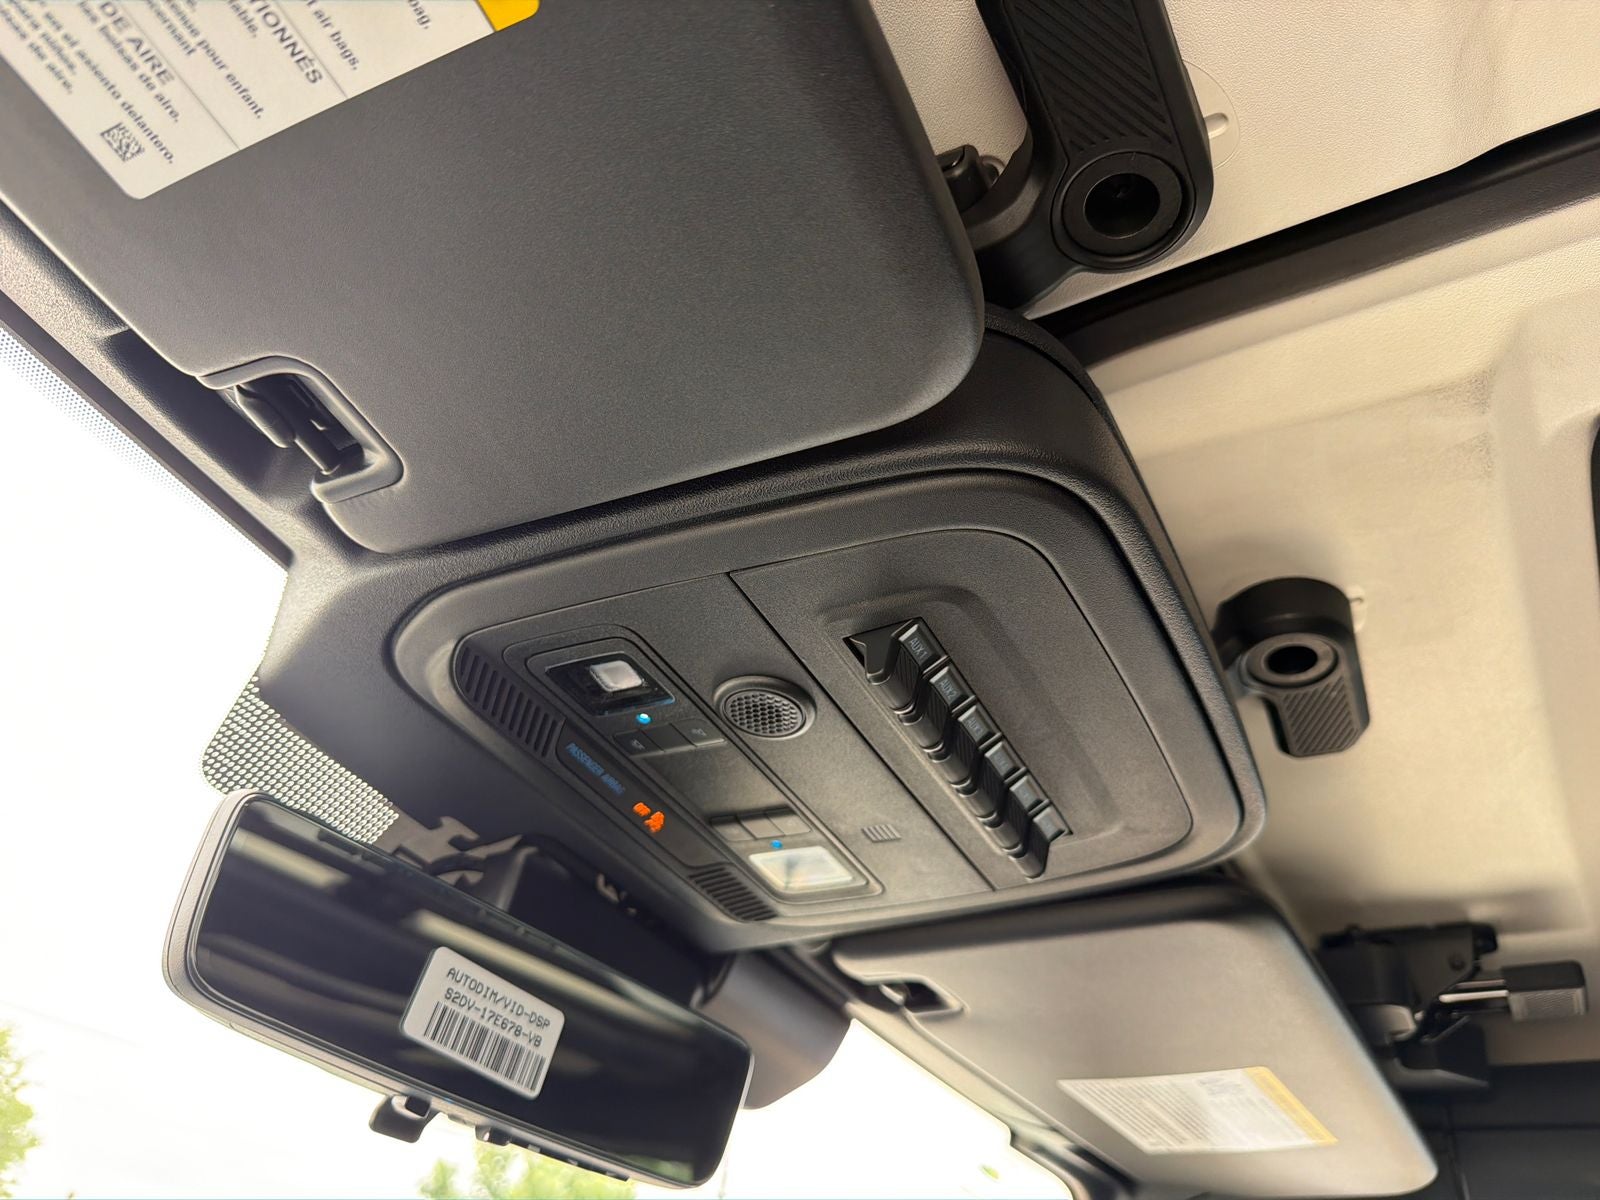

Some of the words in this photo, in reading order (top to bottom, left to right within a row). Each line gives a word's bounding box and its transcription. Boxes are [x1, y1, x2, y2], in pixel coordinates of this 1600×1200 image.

[100, 1, 130, 32] DE
[126, 38, 176, 86] AIRE
[313, 9, 334, 29] air
[329, 30, 359, 71] bags.
[138, 73, 157, 91] de
[154, 93, 180, 122] aire.
[196, 39, 228, 70] pour
[226, 73, 264, 119] enfant.
[120, 101, 174, 165] delantero.
[446, 967, 551, 1030] AUTODIM/VID-DSP
